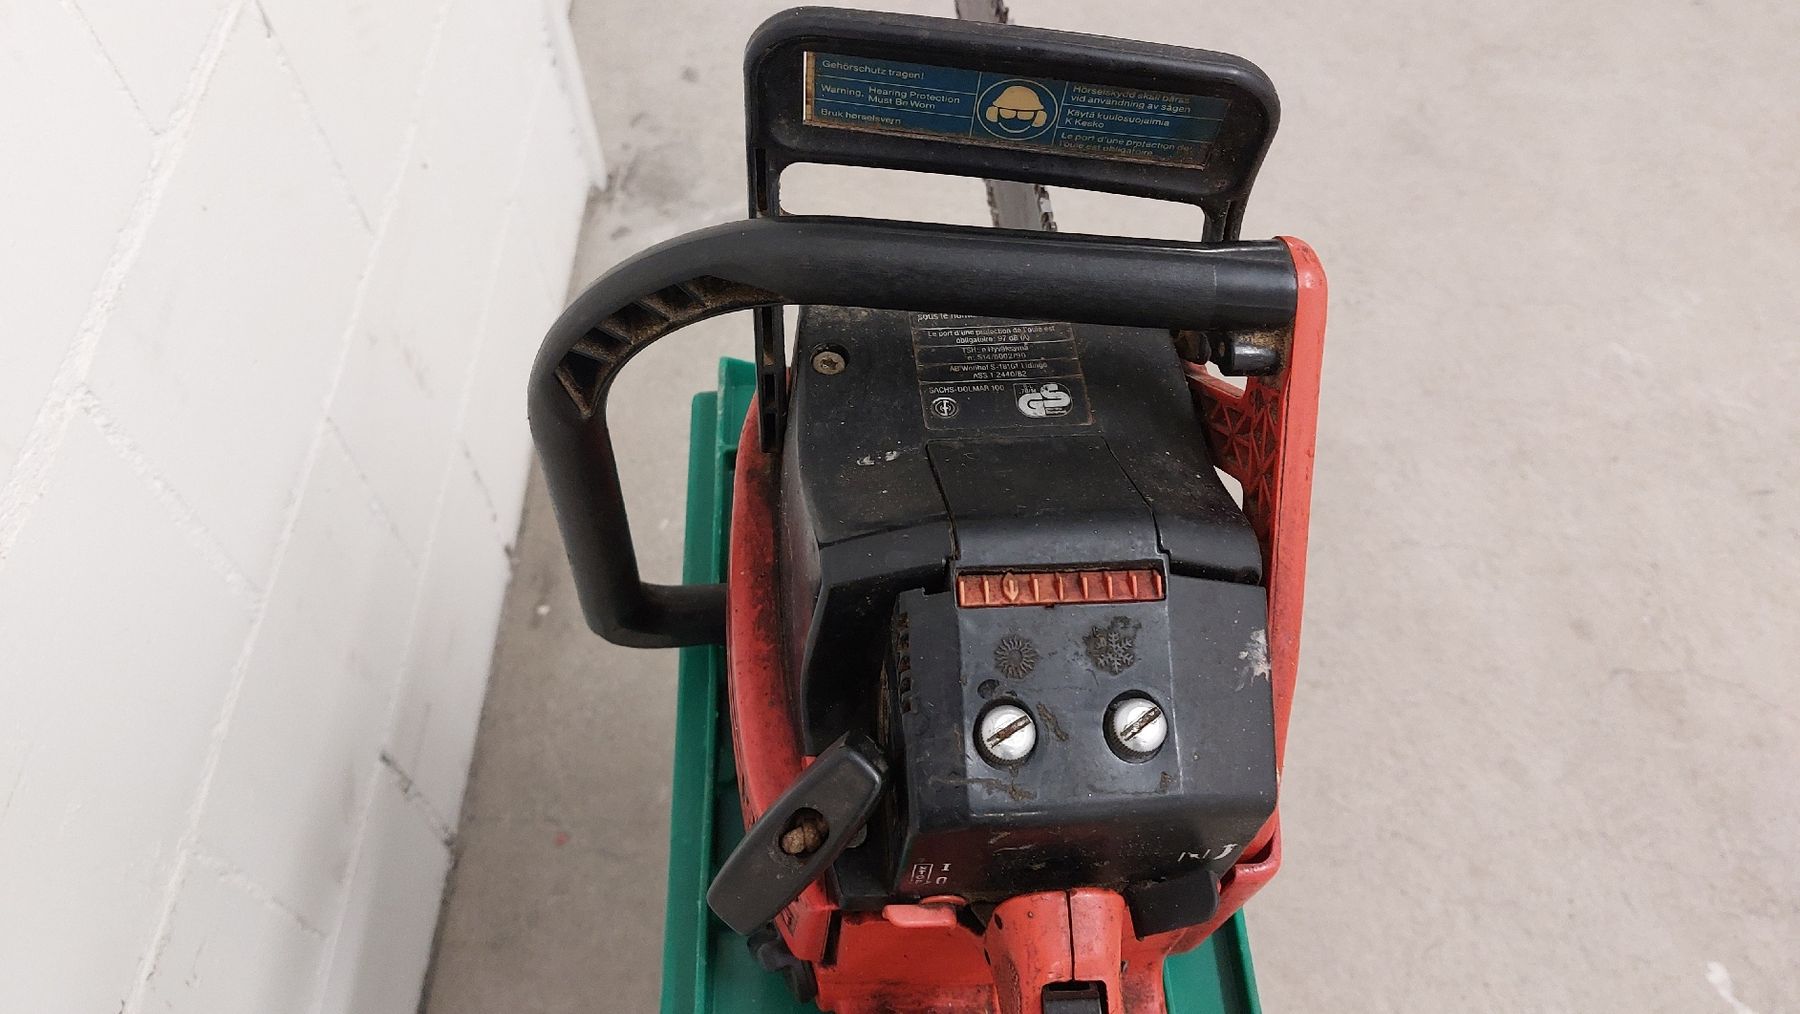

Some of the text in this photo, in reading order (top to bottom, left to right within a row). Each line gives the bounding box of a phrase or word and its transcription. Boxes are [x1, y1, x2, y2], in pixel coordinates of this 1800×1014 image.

[822, 60, 924, 80] Gehörschutz tragen!
[868, 86, 908, 99] Hearing
[910, 91, 960, 104] Protection
[1071, 95, 1086, 103] vid
[868, 95, 936, 110] Must Be Worn
[821, 108, 843, 118] Bruk
[1061, 132, 1073, 140] Le
